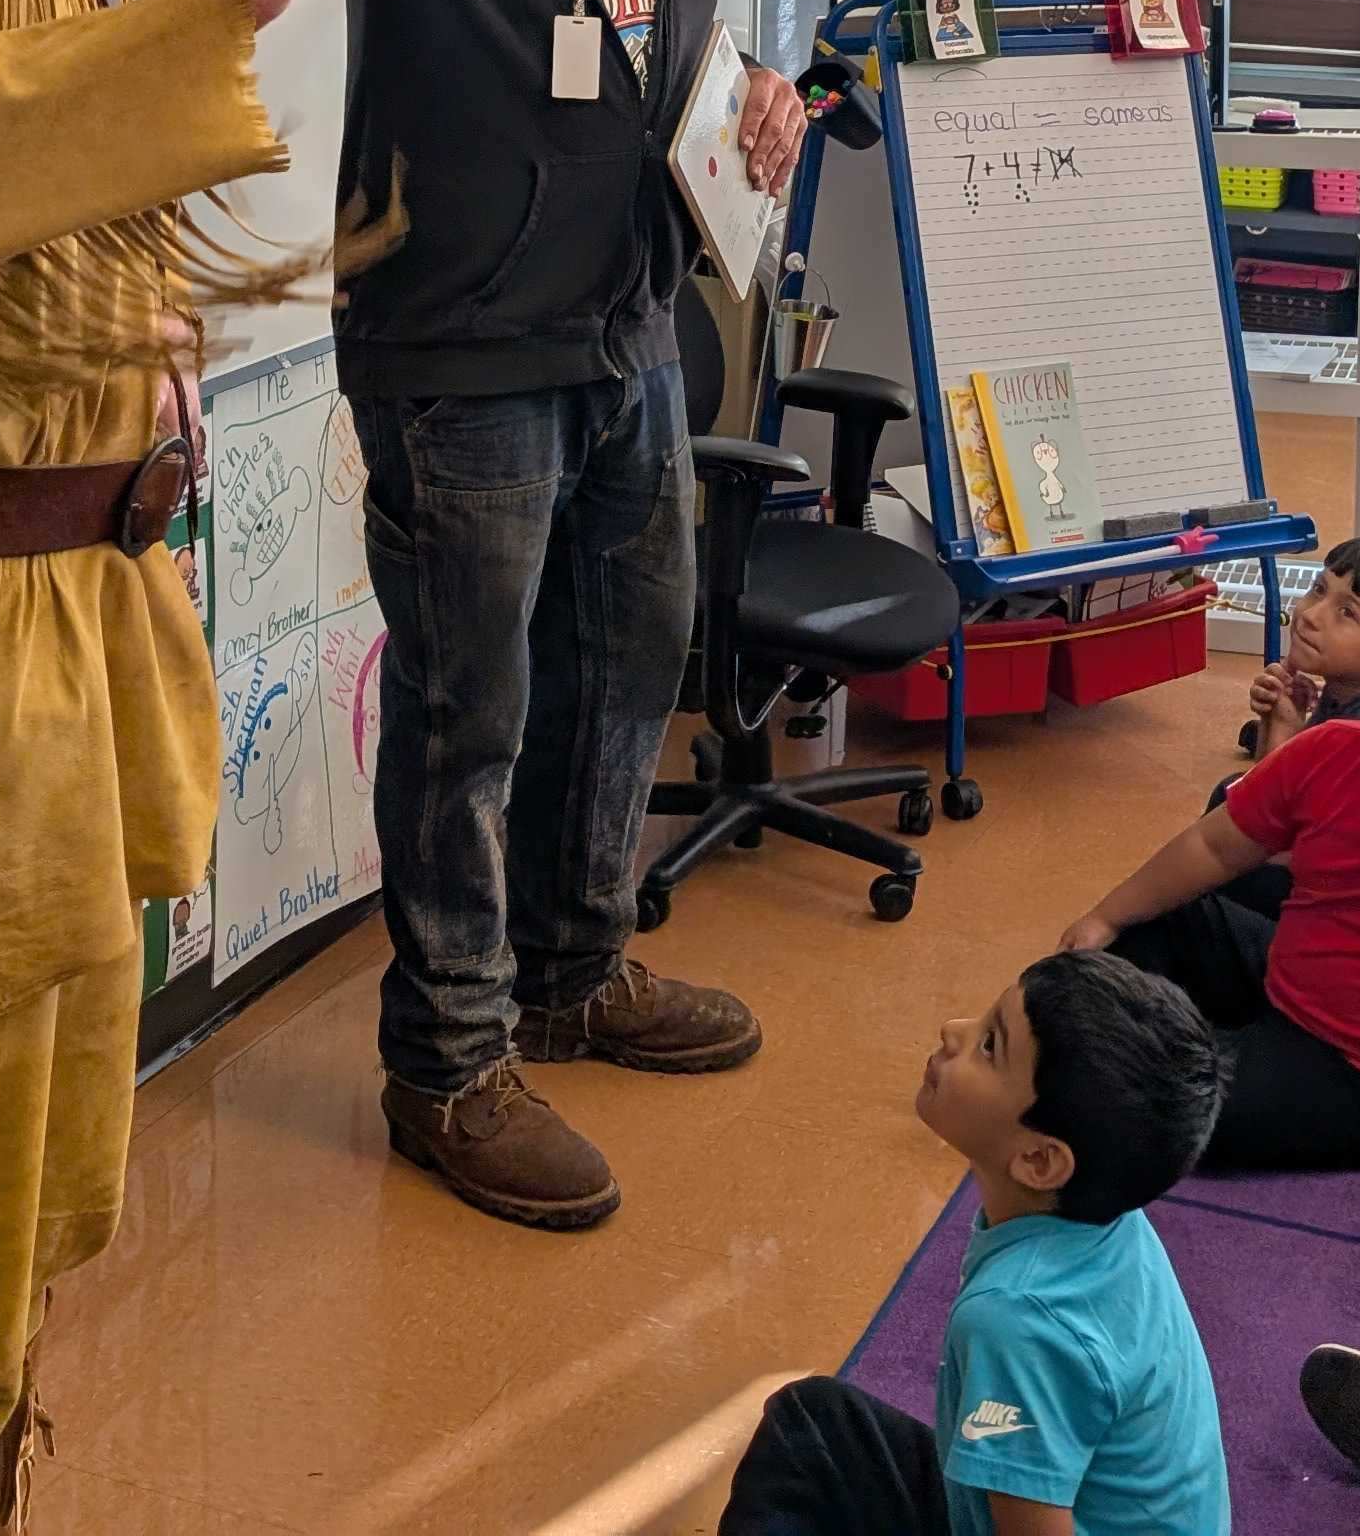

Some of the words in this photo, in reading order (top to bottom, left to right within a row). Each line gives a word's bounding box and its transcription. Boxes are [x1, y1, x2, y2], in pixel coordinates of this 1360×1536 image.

[933, 101, 1018, 145] equal
[1083, 104, 1146, 128] same
[1147, 103, 1174, 125] as
[256, 370, 294, 413] The
[993, 369, 1071, 406] CHICKEN
[267, 599, 315, 641] Brother
[225, 906, 270, 962] Quiet
[279, 865, 343, 925] Brother
[976, 1400, 1023, 1427] NIKE
